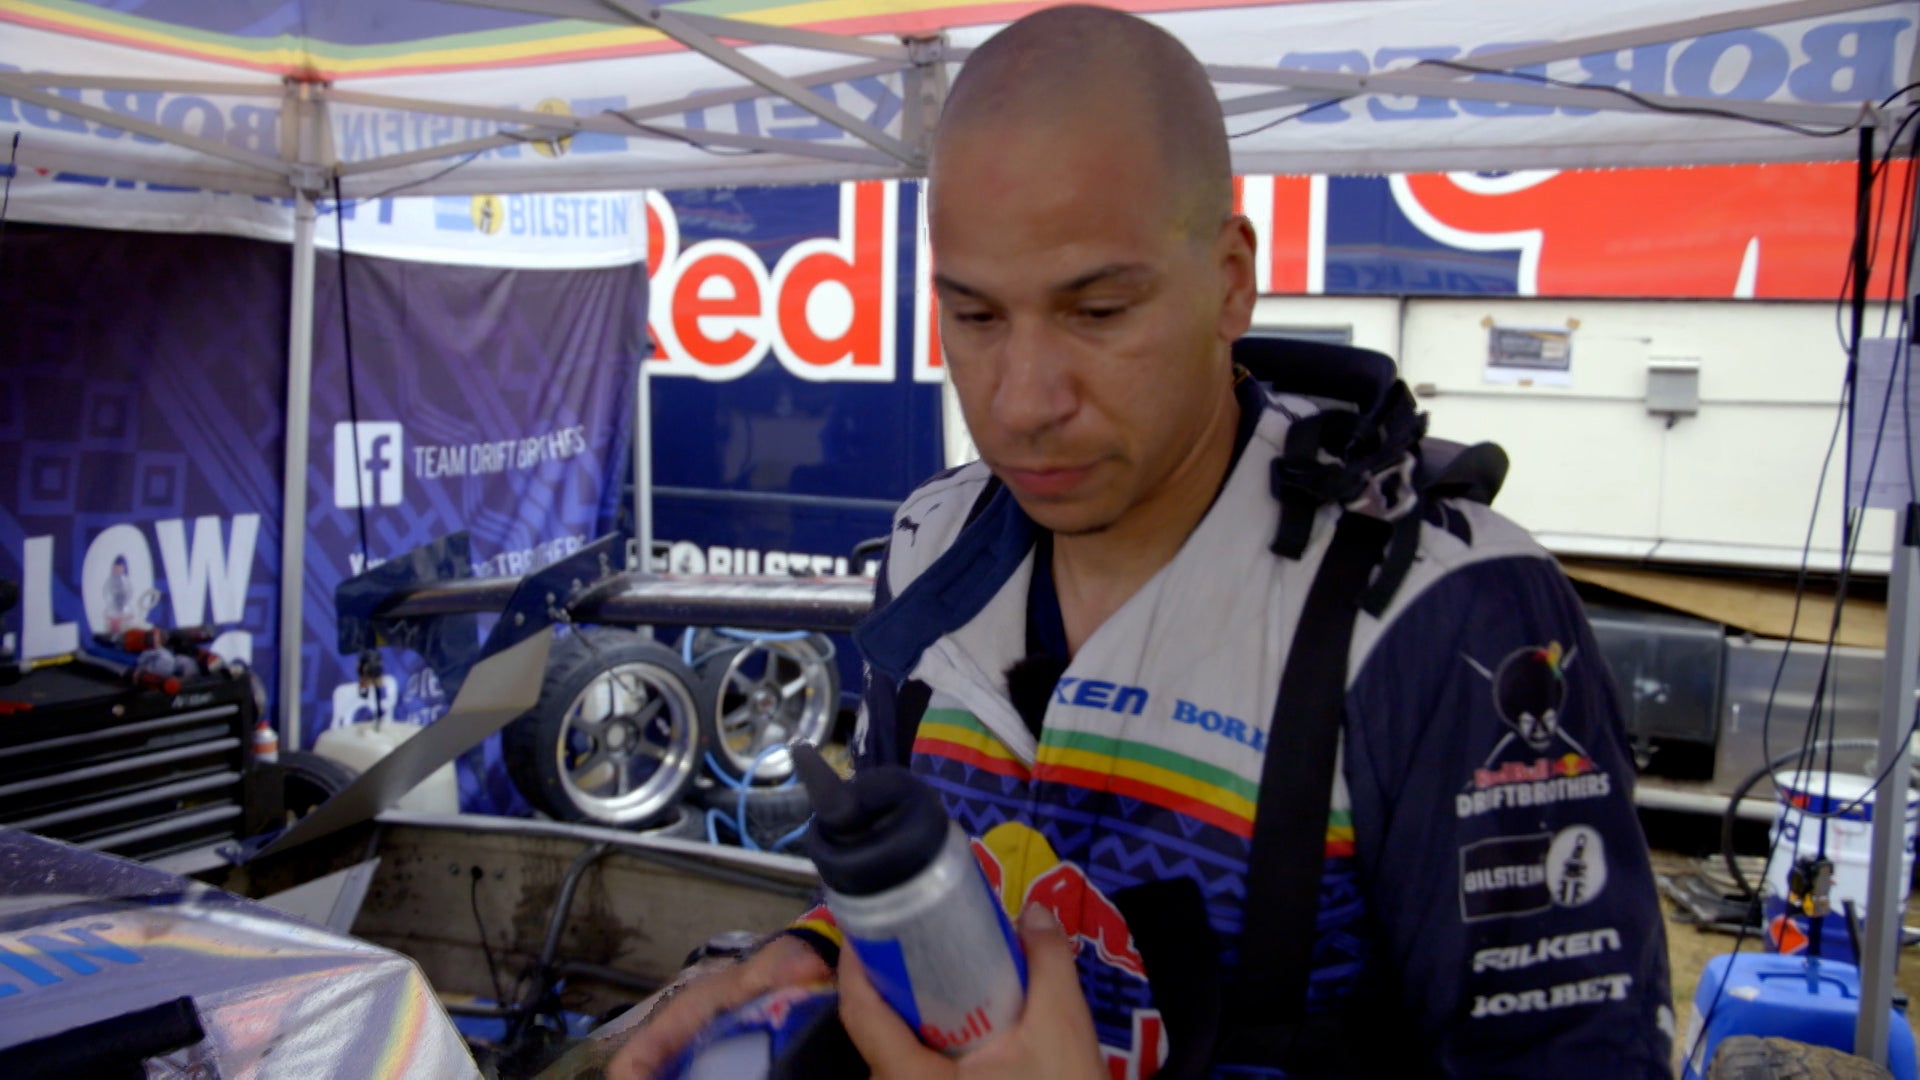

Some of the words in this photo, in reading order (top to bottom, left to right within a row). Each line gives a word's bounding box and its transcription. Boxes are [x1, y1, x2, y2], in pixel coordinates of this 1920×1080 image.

[509, 193, 630, 236] BILSTEIN
[414, 444, 466, 479] TEAM
[1456, 773, 1611, 818] DRIFTBROTHERS
[1465, 864, 1545, 893] BILSTEIN
[1472, 927, 1622, 973] FALKEN
[919, 1006, 992, 1050] Bull
